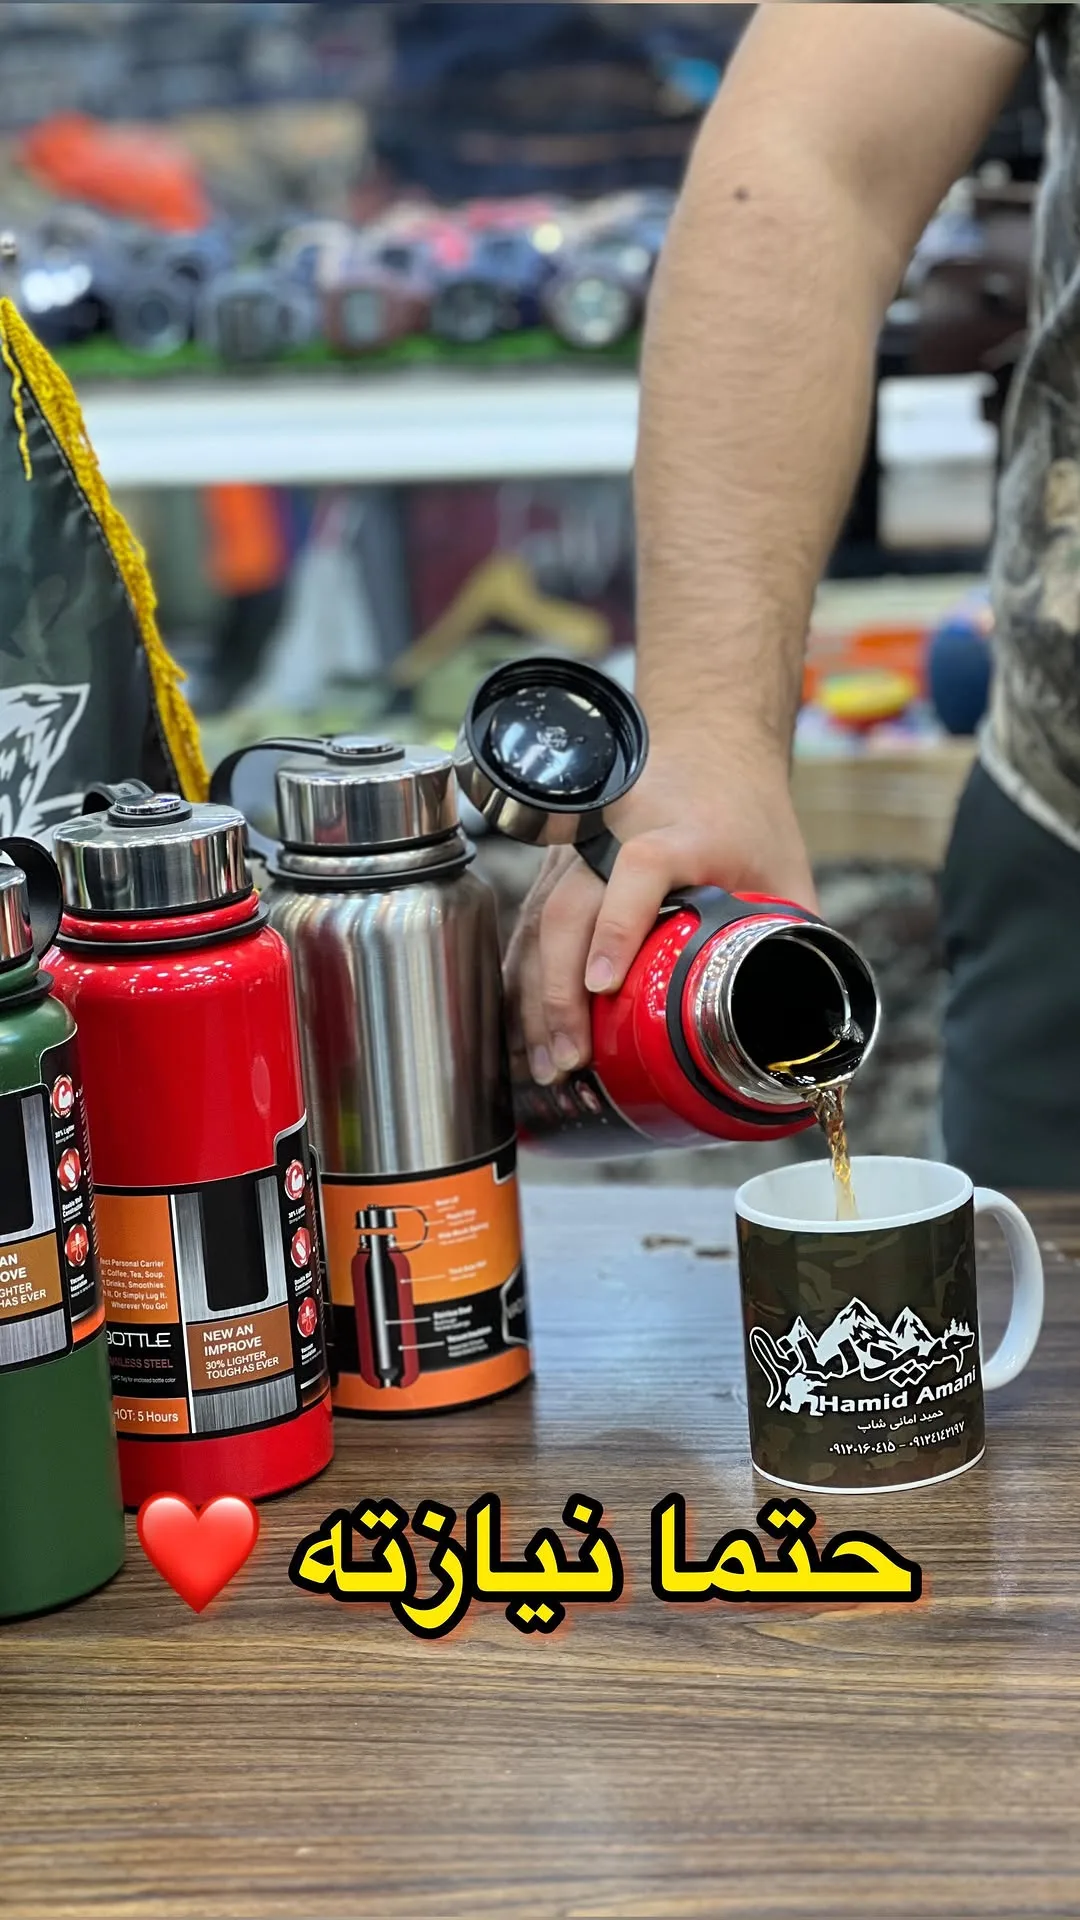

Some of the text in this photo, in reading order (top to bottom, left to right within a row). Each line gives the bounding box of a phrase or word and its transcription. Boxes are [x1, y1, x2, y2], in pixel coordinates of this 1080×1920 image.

[111, 1259, 139, 1268] Personal
[140, 1260, 164, 1268] Carrier
[0, 1267, 27, 1283] OVE
[20, 1289, 47, 1304] EVER
[122, 1291, 145, 1301] Simply
[146, 1292, 159, 1301] Lug
[111, 1301, 140, 1310] Wherever
[141, 1302, 154, 1310] You
[203, 1324, 254, 1342] NEW AN
[204, 1336, 262, 1356] IMPROVE
[143, 1358, 174, 1369] STEEL
[205, 1350, 267, 1370] 30% LIGHTER
[206, 1357, 279, 1380] TOUGH AS EVER
[820, 1365, 976, 1412] Hamid Amani
[137, 1411, 144, 1422] 5
[146, 1411, 179, 1422] Hours
[857, 1409, 944, 1434] حمید امانی شاپ
